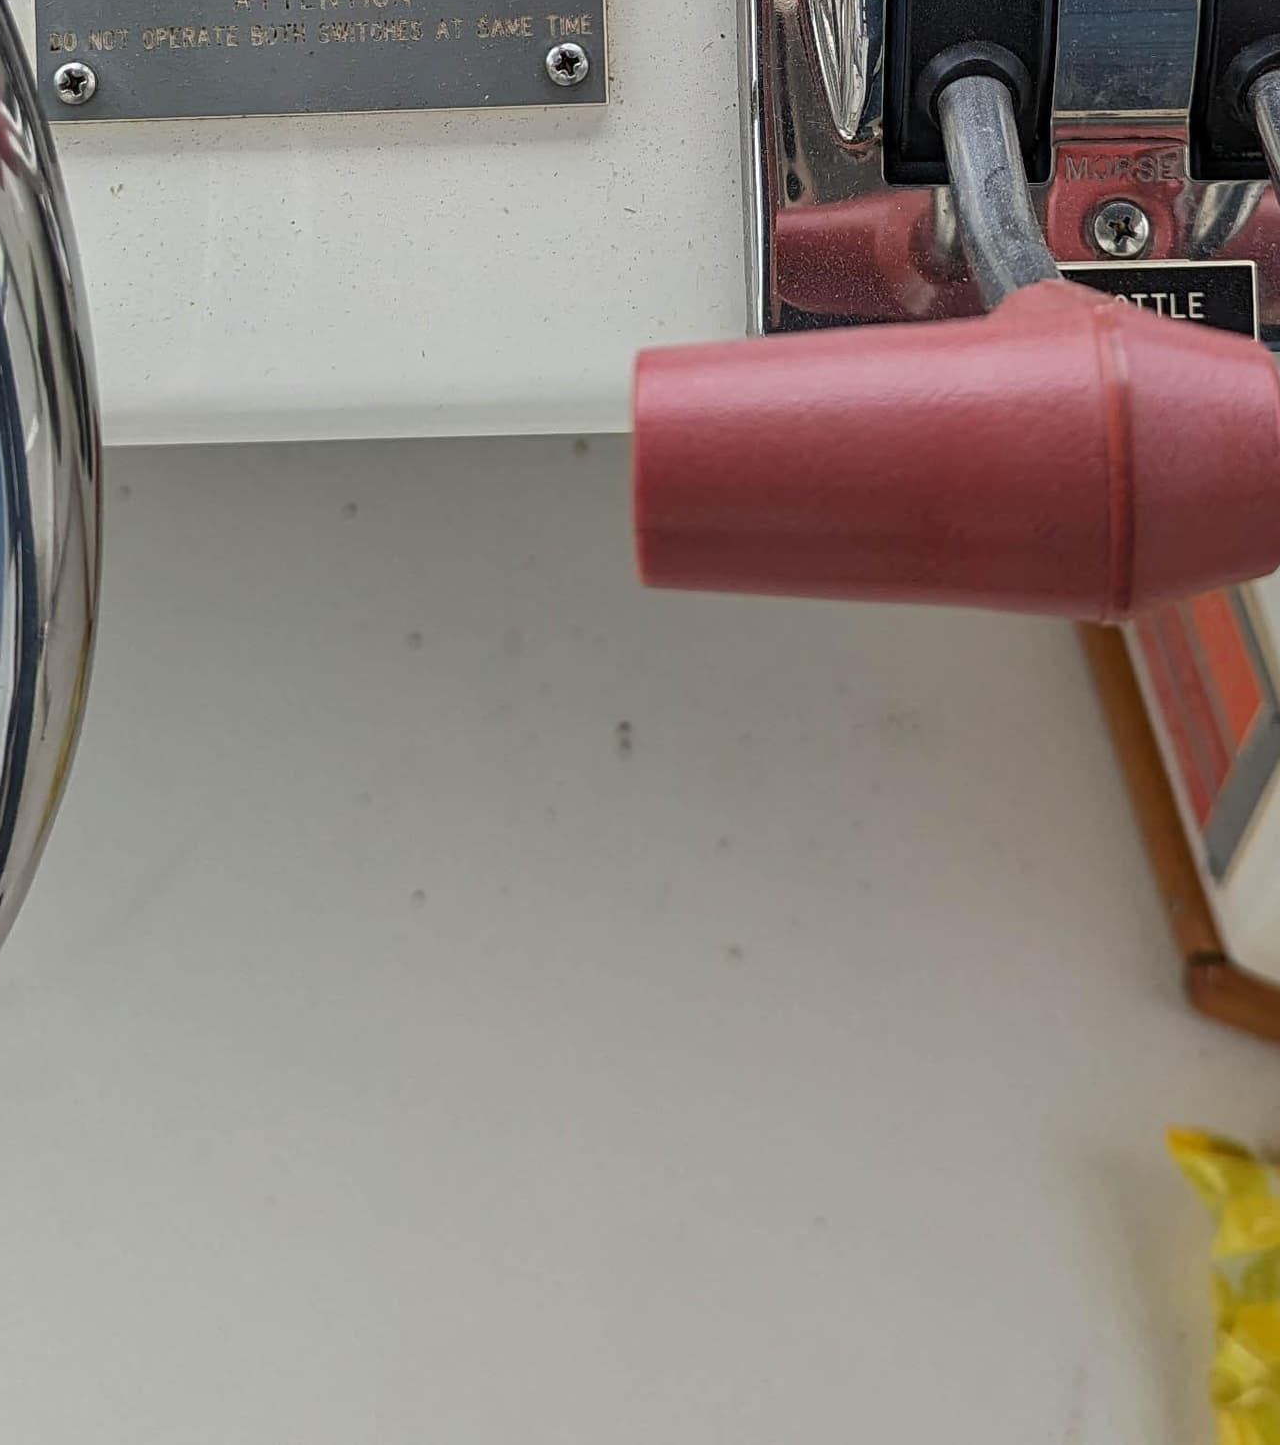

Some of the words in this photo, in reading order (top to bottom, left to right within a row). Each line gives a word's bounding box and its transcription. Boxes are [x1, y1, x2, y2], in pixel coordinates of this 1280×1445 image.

[49, 31, 78, 52] DO
[86, 28, 129, 52] NOT
[142, 25, 240, 50] OPERATE
[250, 22, 306, 47] BOTH
[319, 18, 424, 44] SWITCHES
[435, 17, 464, 42] AT
[476, 14, 535, 39] SAME
[545, 13, 593, 36] TIME
[1064, 153, 1181, 184] MORSE
